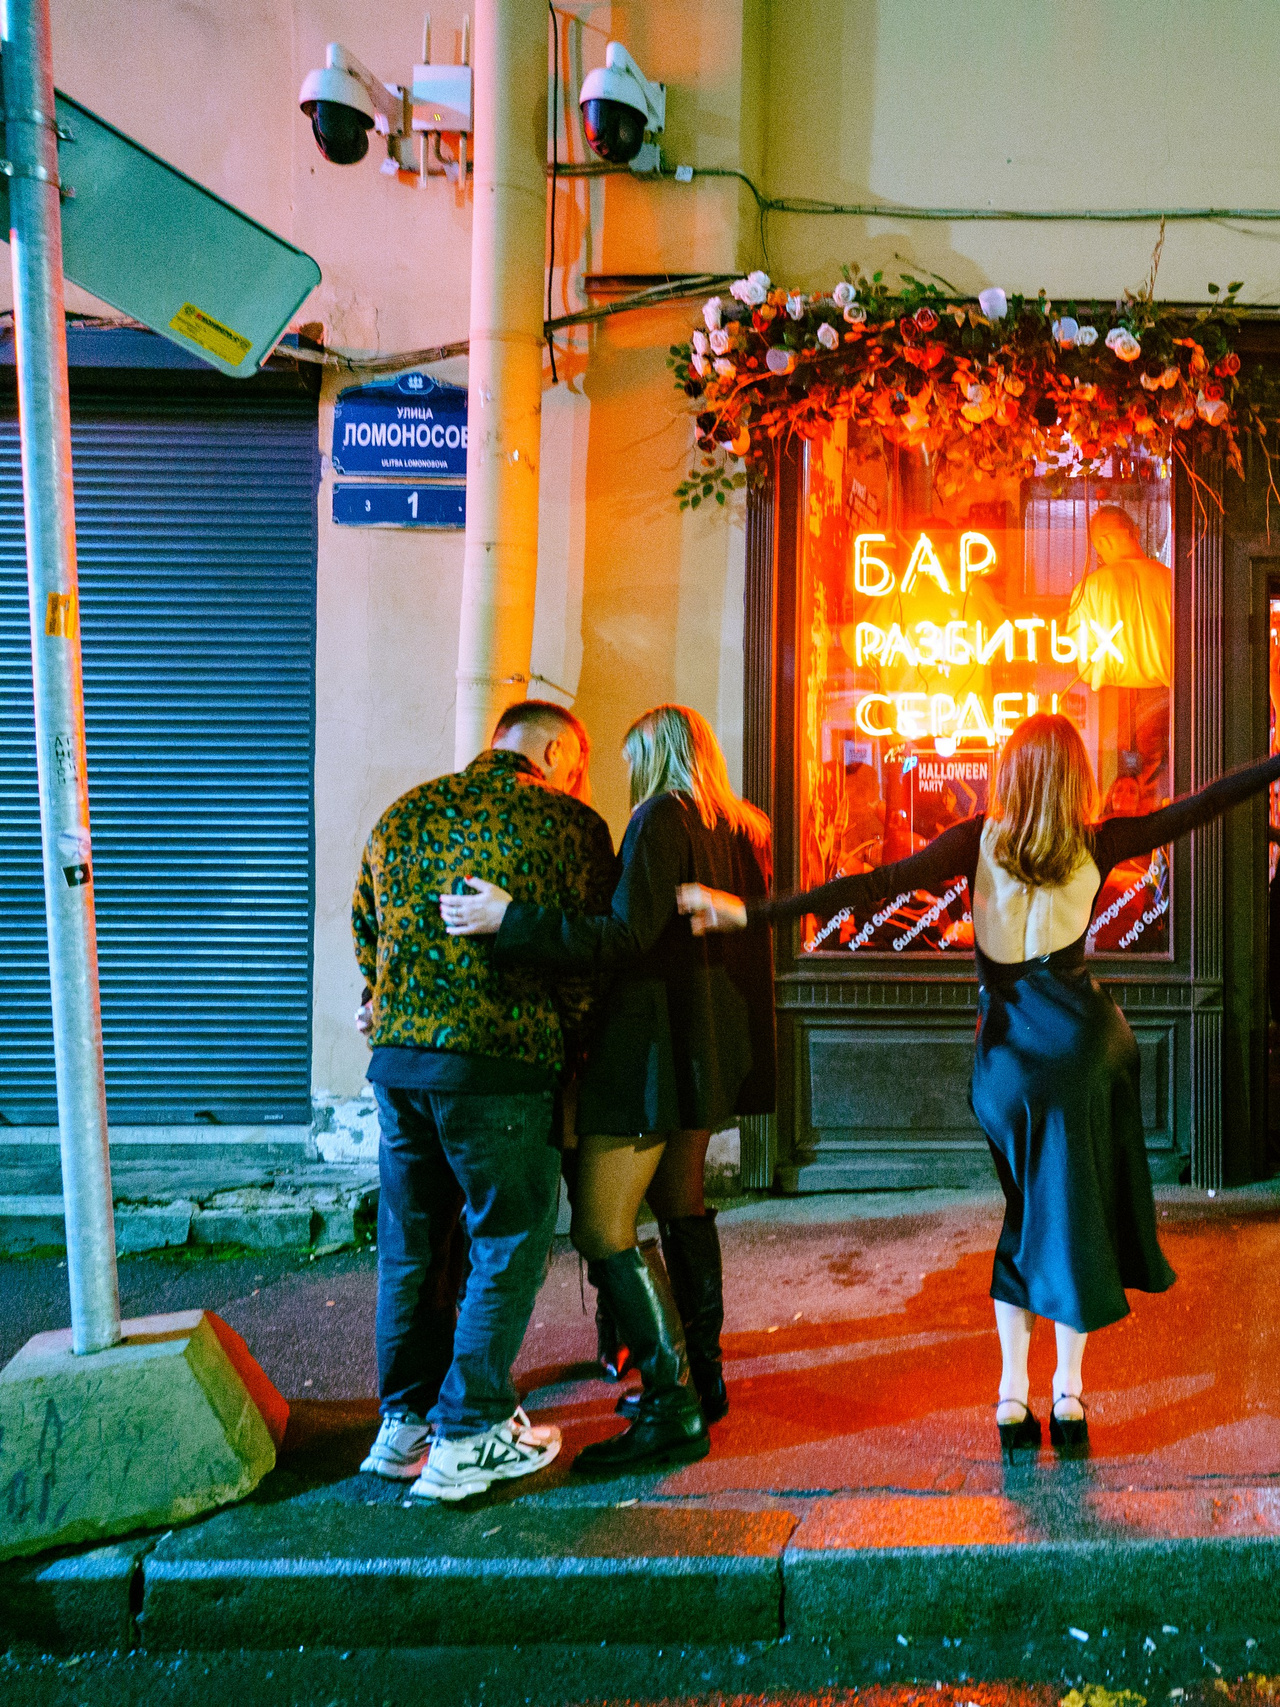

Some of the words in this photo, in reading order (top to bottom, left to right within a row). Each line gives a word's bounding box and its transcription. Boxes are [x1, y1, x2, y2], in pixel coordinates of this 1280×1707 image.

[397, 407, 433, 421] УЛИЦА
[343, 422, 468, 449] ЛОМОНОСО
[407, 491, 419, 519] 1
[854, 531, 997, 596] БАР
[855, 618, 1125, 667] РАЗБИТЫХ
[918, 762, 988, 780] HALLOWEEN
[919, 780, 943, 792] PARTY
[1134, 863, 1159, 892] клуб
[893, 889, 957, 951] бильярдный
[1119, 919, 1144, 949] клуб
[848, 921, 875, 951] клуб
